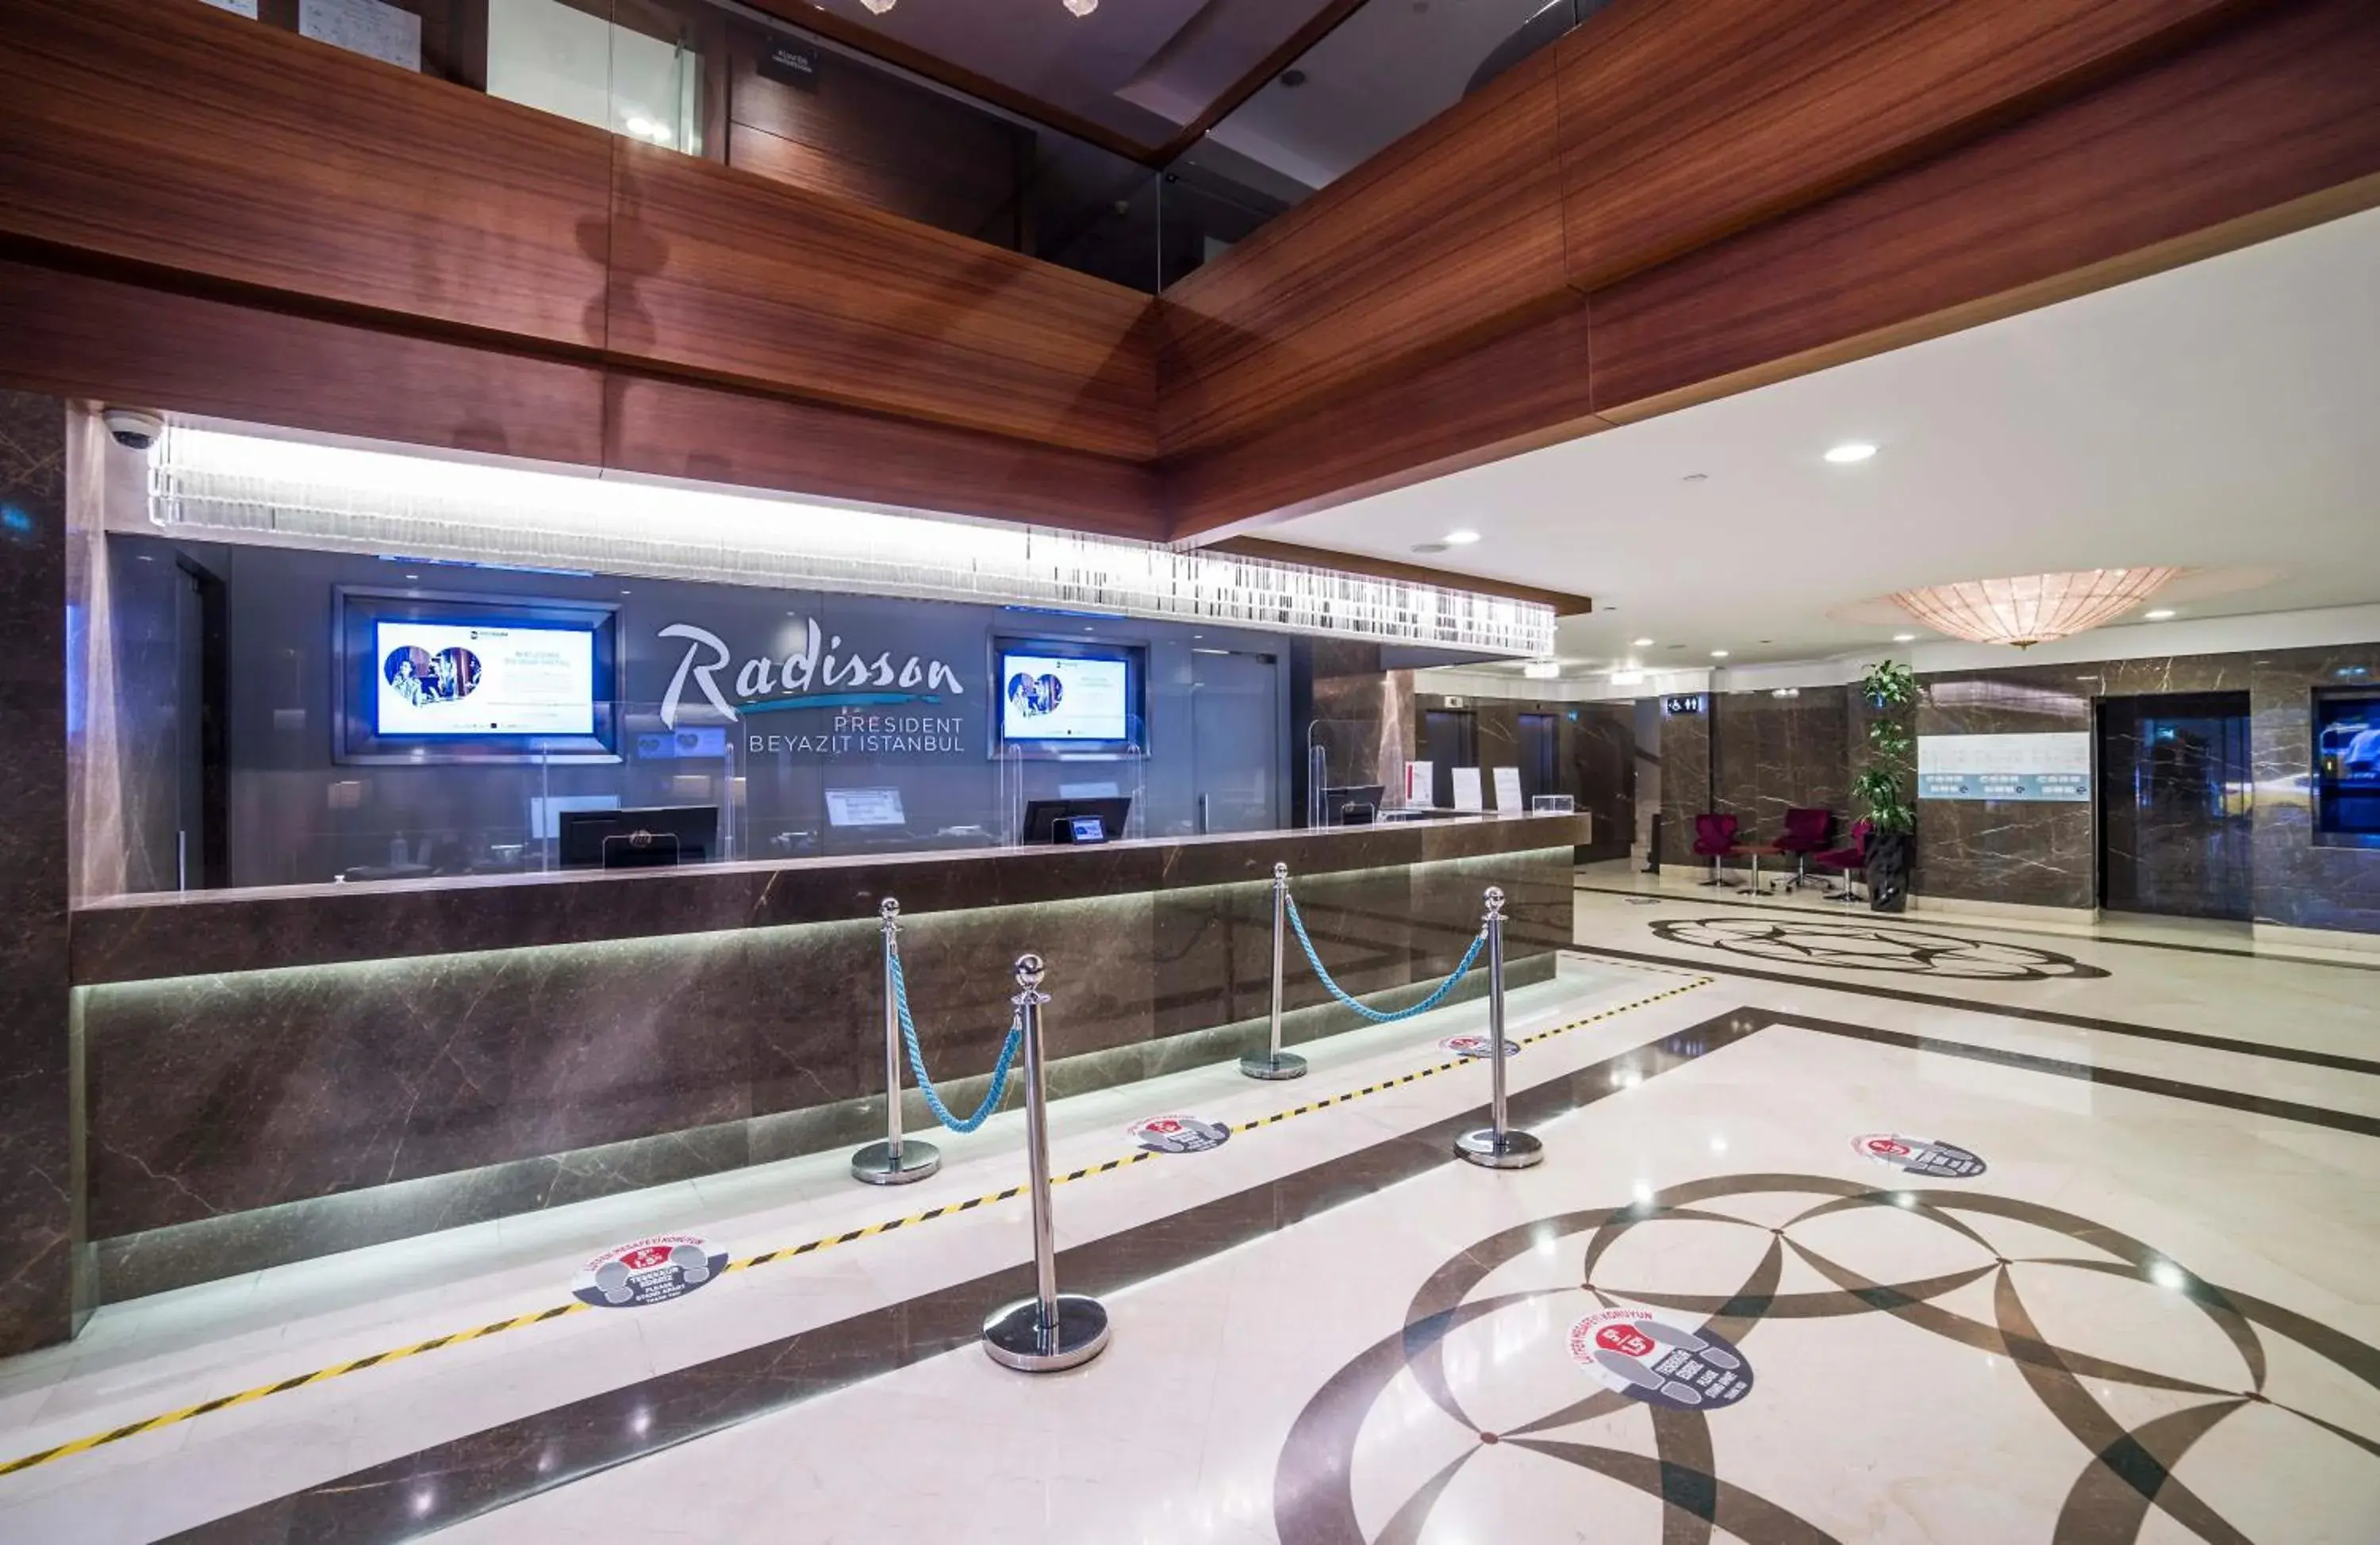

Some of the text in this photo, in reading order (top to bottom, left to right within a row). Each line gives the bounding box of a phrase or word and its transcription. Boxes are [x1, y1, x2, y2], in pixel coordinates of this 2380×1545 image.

[658, 616, 965, 730] Radisson
[834, 715, 963, 734] PRESIDENT
[749, 735, 965, 753] BEYAZIT ISTANBUL
